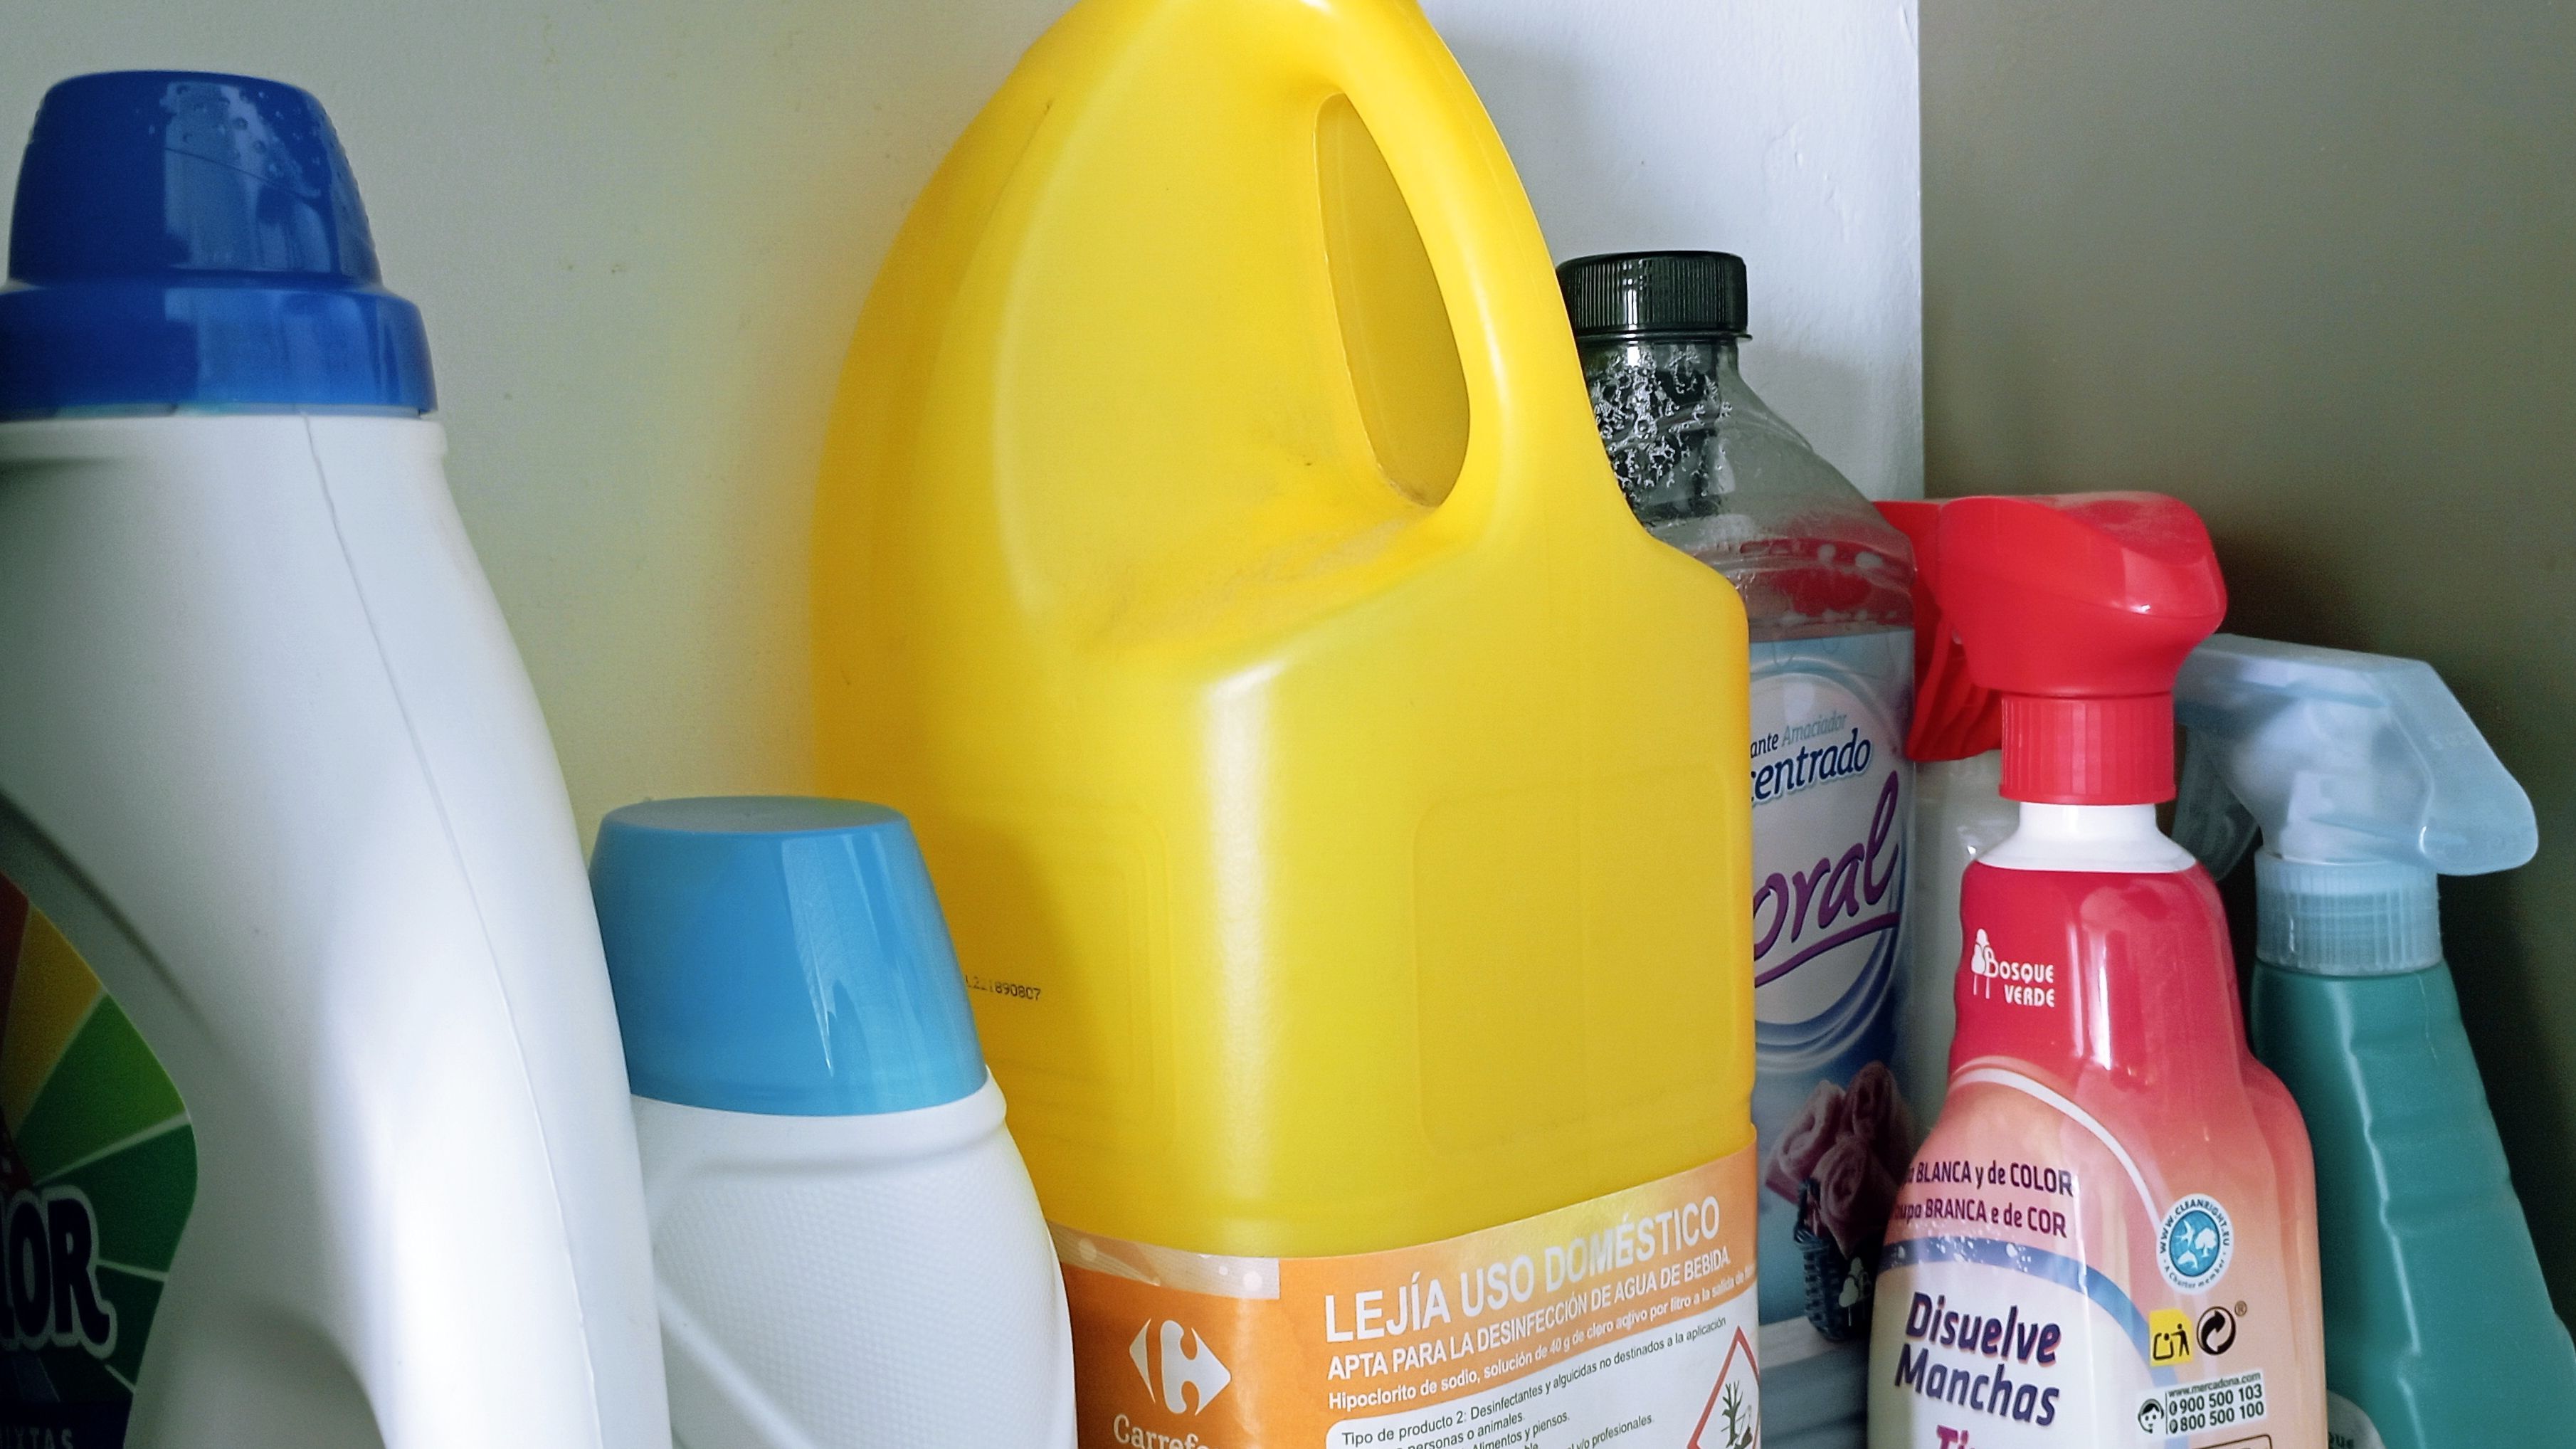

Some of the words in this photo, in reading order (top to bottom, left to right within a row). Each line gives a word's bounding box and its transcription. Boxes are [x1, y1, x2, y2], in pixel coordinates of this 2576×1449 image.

[1782, 710, 1847, 747] Amaciador
[1751, 727, 1871, 802] entrado
[1983, 946, 2054, 984] BOSQUE
[2004, 984, 2055, 1008] VERDE
[1916, 1160, 1972, 1184] BLANCA
[1975, 1166, 1984, 1190] y
[1988, 1160, 2006, 1185] de
[2010, 1162, 2074, 1197] COLOR
[1926, 1198, 1987, 1223] BRANCA
[1990, 1207, 1999, 1225] e
[2003, 1203, 2022, 1228] de
[2027, 1206, 2067, 1238] COR
[0, 1193, 114, 1352] OR
[1325, 1271, 1451, 1343] LEJÍA
[1460, 1255, 1535, 1317] USO
[1544, 1196, 1720, 1293] DOMÉSTICO
[1327, 1351, 1388, 1381] APTA
[1393, 1339, 1447, 1373] PARA
[1450, 1332, 1475, 1360] LA
[1477, 1292, 1588, 1352] DESINFECCIÓN
[1590, 1284, 1611, 1311] DE
[1614, 1270, 1657, 1304] AGUA
[1660, 1263, 1681, 1290] DE
[1905, 1291, 2061, 1366] Disuelve
[1329, 1384, 1417, 1412] Hipoclorito
[1420, 1379, 1437, 1396] de
[1441, 1368, 1481, 1391] sodio,
[1484, 1351, 1532, 1379] solución
[1534, 1343, 1548, 1359] de
[1549, 1338, 1562, 1354] 40
[1563, 1336, 1571, 1348] g
[1572, 1328, 1584, 1344] de
[1650, 1303, 1669, 1322] por
[1671, 1295, 1691, 1312] litro
[1693, 1294, 1700, 1305] a
[1701, 1286, 1711, 1301] la
[1342, 1431, 1373, 1448] Tipo
[1377, 1428, 1395, 1442] de
[1398, 1416, 1453, 1441] producto
[1470, 1384, 1543, 1421] Desinfectantes
[1545, 1381, 1551, 1395] y
[1553, 1362, 1598, 1389] alguicidas
[1599, 1357, 1612, 1370] no
[1614, 1340, 1665, 1365] destinados
[1667, 1338, 1673, 1347] a
[1675, 1332, 1684, 1344] la
[1686, 1316, 1726, 1342] aplicación
[1894, 1342, 2060, 1427] Manchas
[2168, 1371, 2261, 1398] www.mercadona.com
[2180, 1395, 2205, 1415] 900
[2208, 1389, 2234, 1408] 500
[2238, 1383, 2263, 1402] 103
[1467, 1429, 1474, 1440] o
[1524, 1427, 1531, 1439] y
[1532, 1411, 1570, 1438] piensos.
[2180, 1413, 2206, 1432] 800
[2210, 1406, 2235, 1426] 500
[2239, 1401, 2264, 1420] 100
